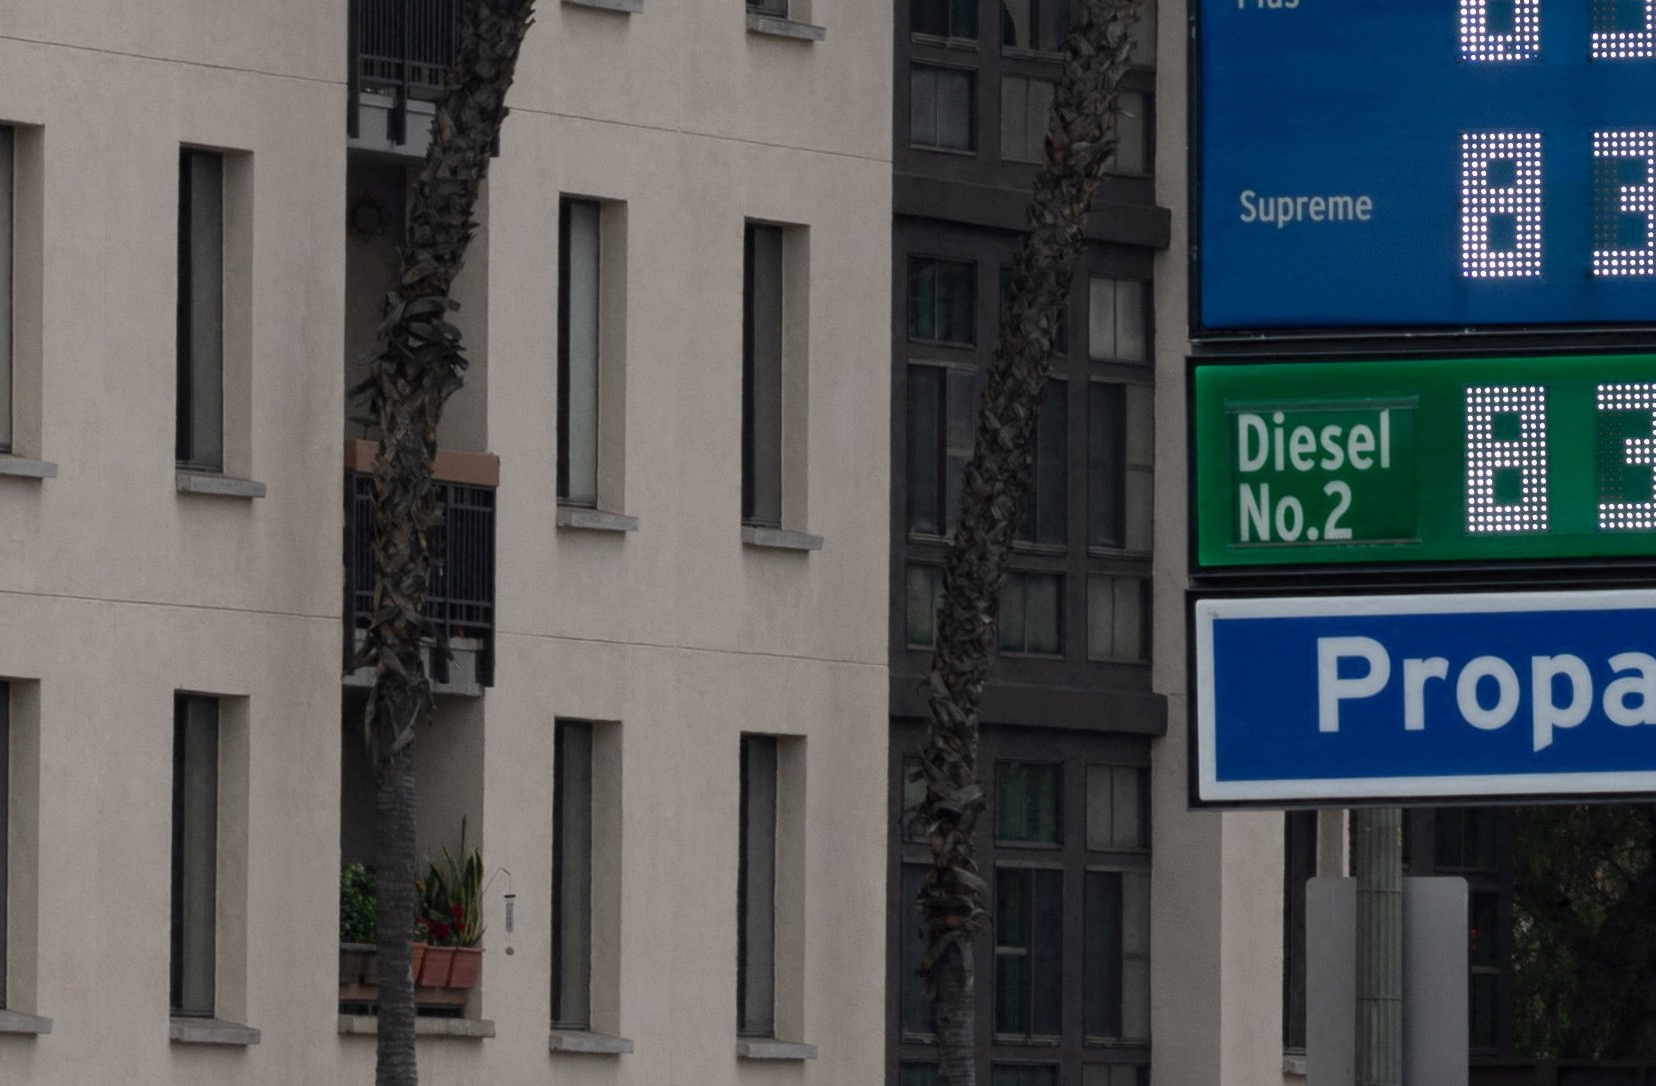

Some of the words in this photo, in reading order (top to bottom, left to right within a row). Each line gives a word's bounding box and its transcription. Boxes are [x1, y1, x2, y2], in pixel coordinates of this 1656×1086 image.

[1238, 189, 1374, 228] Supreme
[1236, 409, 1393, 474] Diesel
[1237, 479, 1355, 544] No.2
